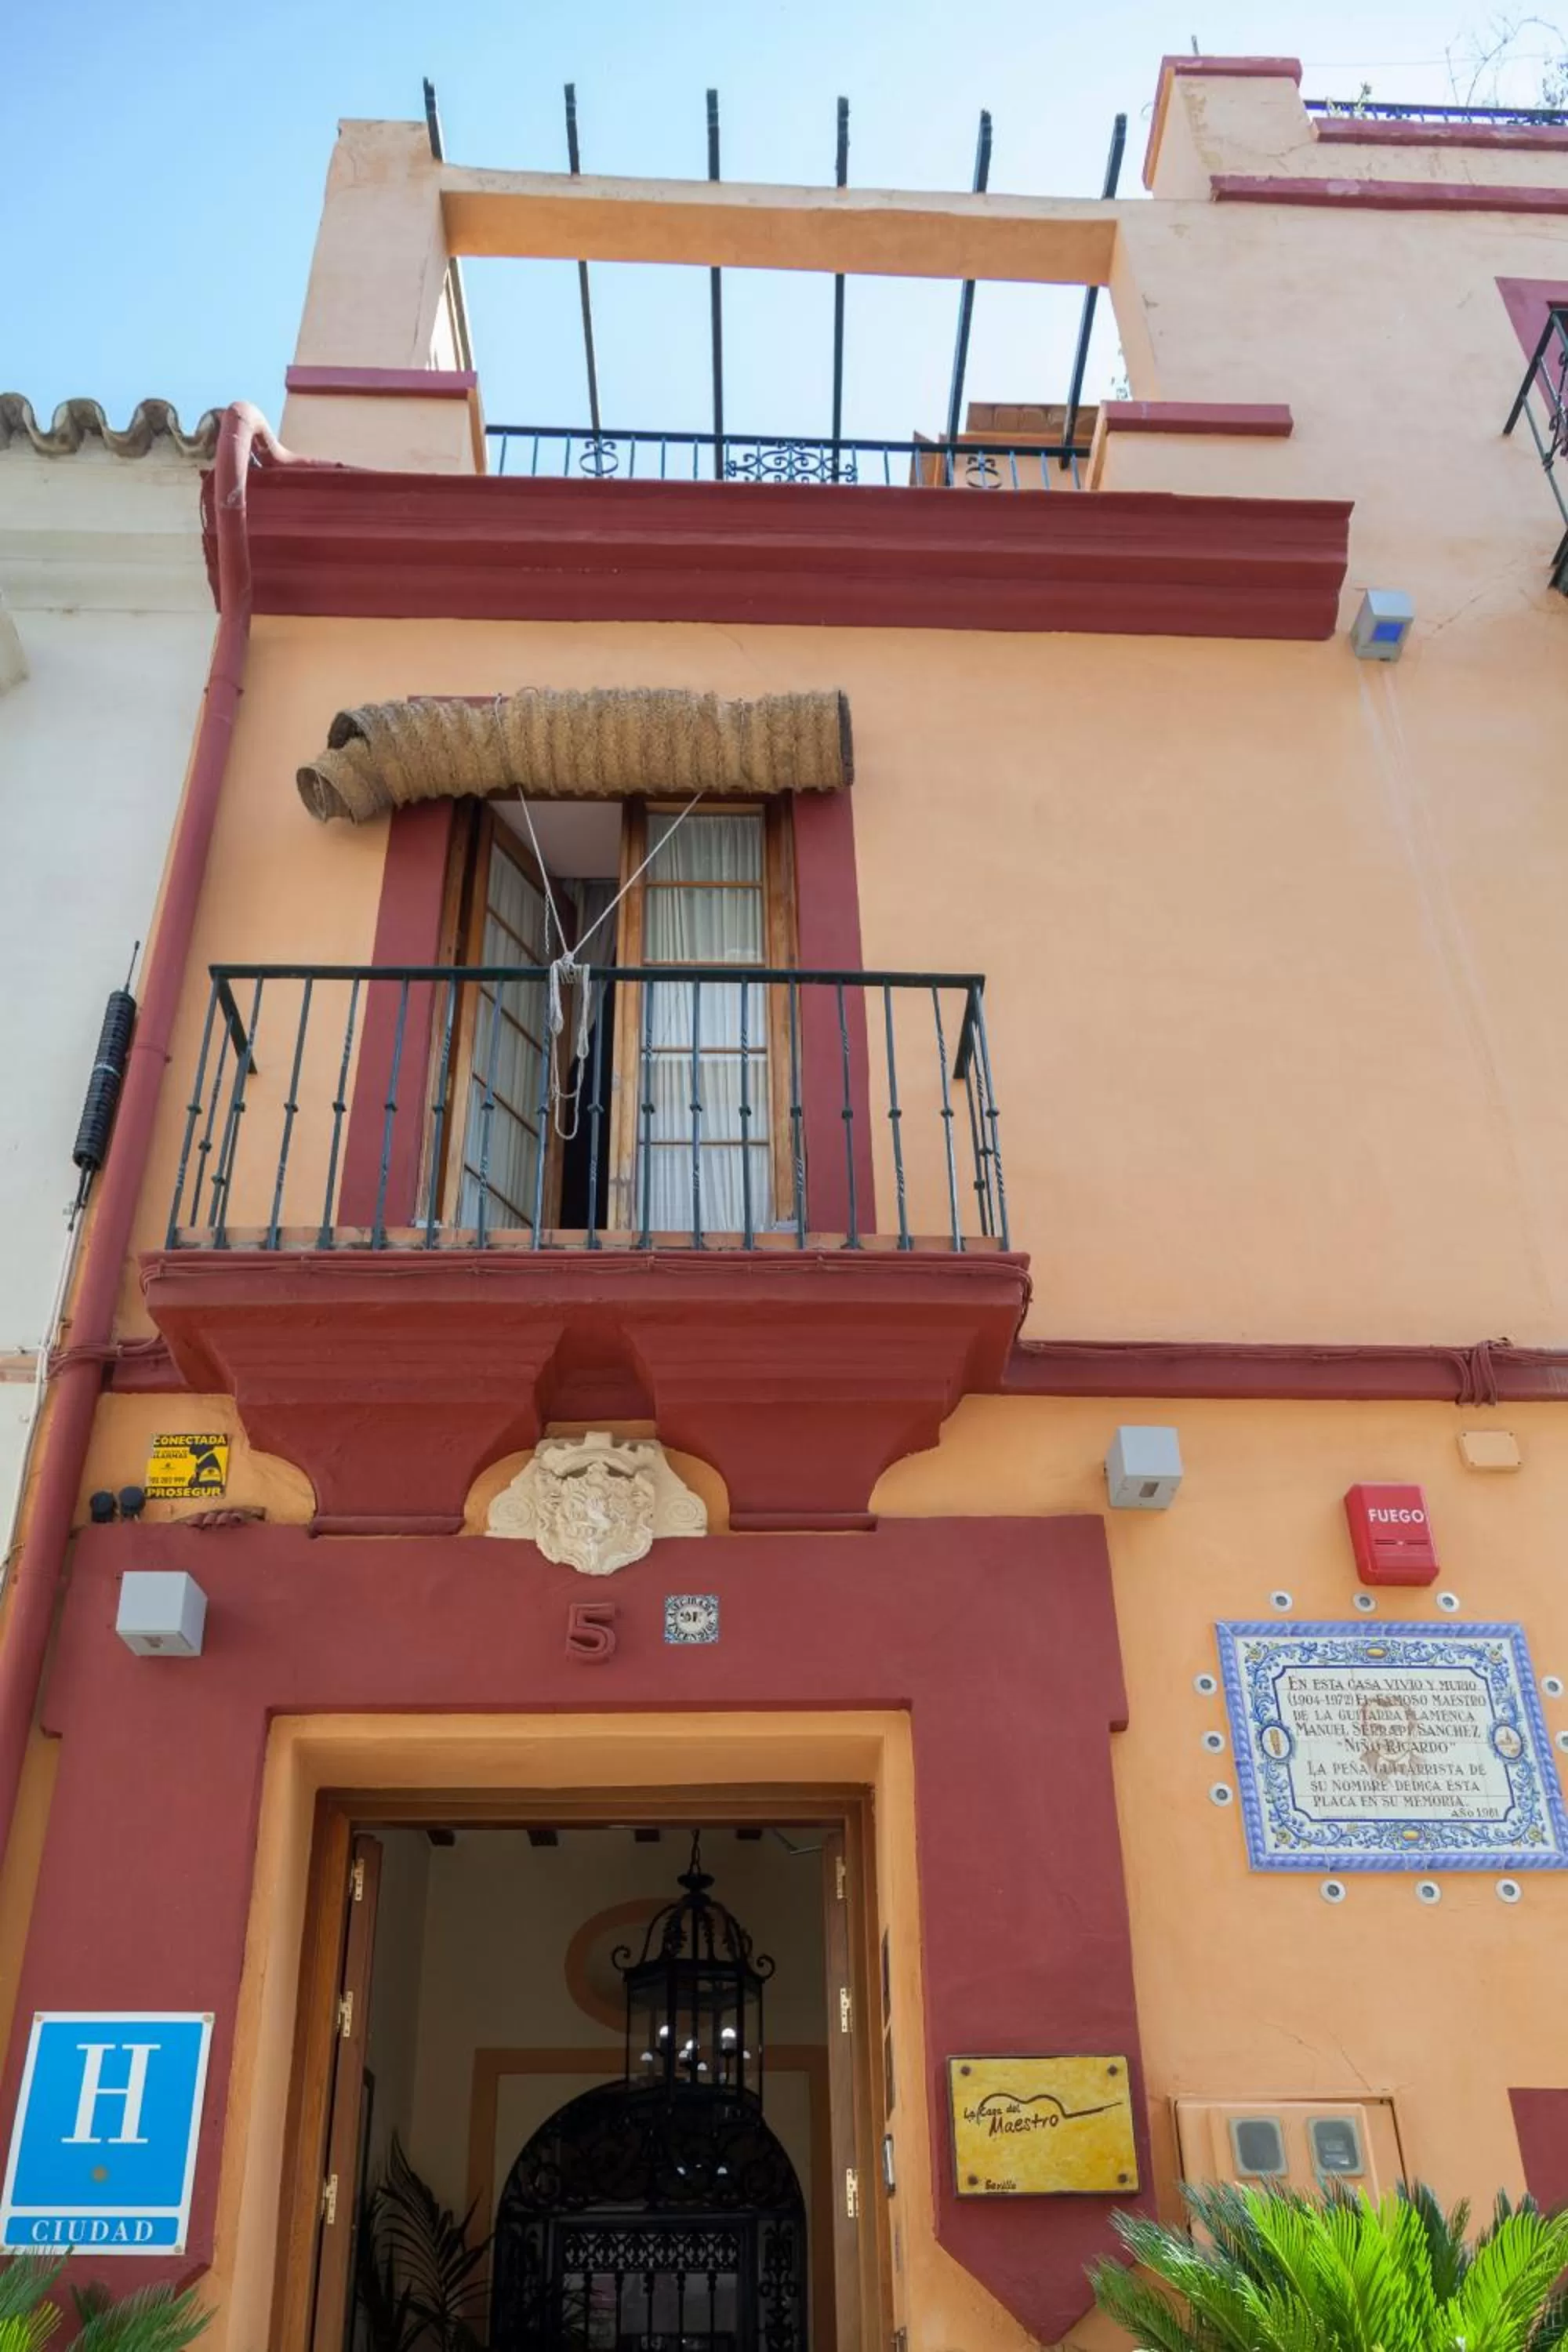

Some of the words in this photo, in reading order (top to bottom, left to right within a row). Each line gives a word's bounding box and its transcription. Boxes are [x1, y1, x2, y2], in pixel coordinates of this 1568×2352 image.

[154, 1436, 226, 1445] CONECTADA
[147, 1487, 220, 1497] PROSEGUR
[1368, 1508, 1425, 1523] FUEGO
[566, 1602, 616, 1663] 5
[1288, 1675, 1307, 1690] EN
[1312, 1679, 1344, 1690] ESTA
[1348, 1679, 1381, 1690] CASA
[1425, 1679, 1434, 1690] Y
[1288, 1693, 1354, 1707] (1904-1972)
[1432, 1694, 1486, 1706] MAESTRO
[1293, 1710, 1308, 1721] DE
[1314, 1710, 1334, 1721] LA
[1338, 1710, 1403, 1721] GUITARRA
[1405, 1709, 1475, 1722] FLAMENCA
[1296, 1722, 1348, 1737] MANUEL
[1417, 1723, 1481, 1738] SANCHEZ
[1307, 1760, 1327, 1776] LA
[1332, 1760, 1368, 1775] PEÑA
[1374, 1762, 1465, 1776] GUITARRISTA
[1469, 1763, 1486, 1776] DE
[1310, 1780, 1327, 1791] SU
[1332, 1780, 1387, 1791] NOMBRE
[1395, 1780, 1443, 1791] DEDICA
[1446, 1780, 1481, 1791] ESTA
[1313, 1795, 1357, 1807] PLACA
[1360, 1795, 1377, 1807] EN
[1380, 1796, 1398, 1807] SU
[61, 2044, 161, 2143] H
[989, 2114, 1059, 2138] Maestro
[31, 2220, 154, 2242] CIUDAD
